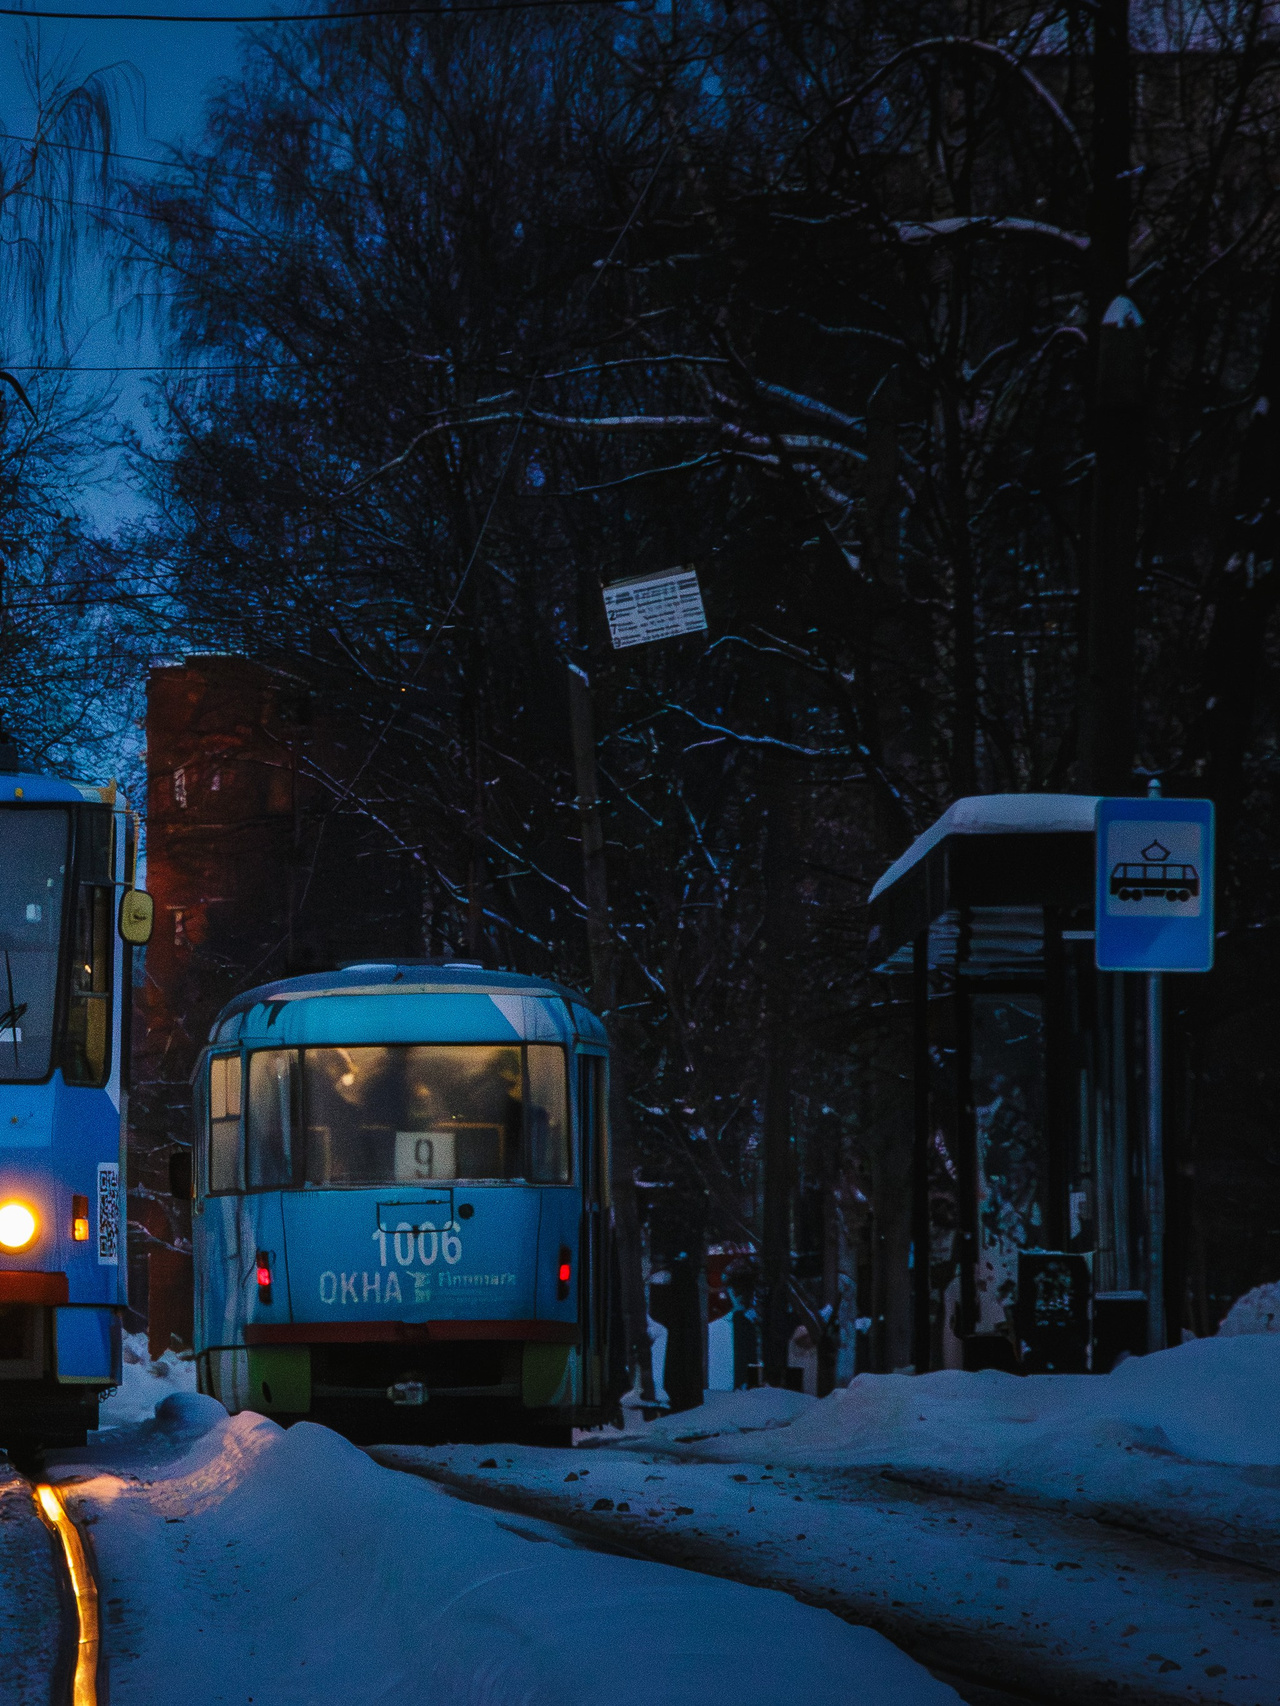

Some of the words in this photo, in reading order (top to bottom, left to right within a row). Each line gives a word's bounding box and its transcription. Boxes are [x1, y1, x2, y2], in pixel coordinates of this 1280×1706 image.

[608, 610, 616, 621] 2
[610, 624, 616, 635] 7
[415, 1138, 434, 1179] 9
[372, 1220, 463, 1267] 1006
[319, 1270, 403, 1304] ОКНА
